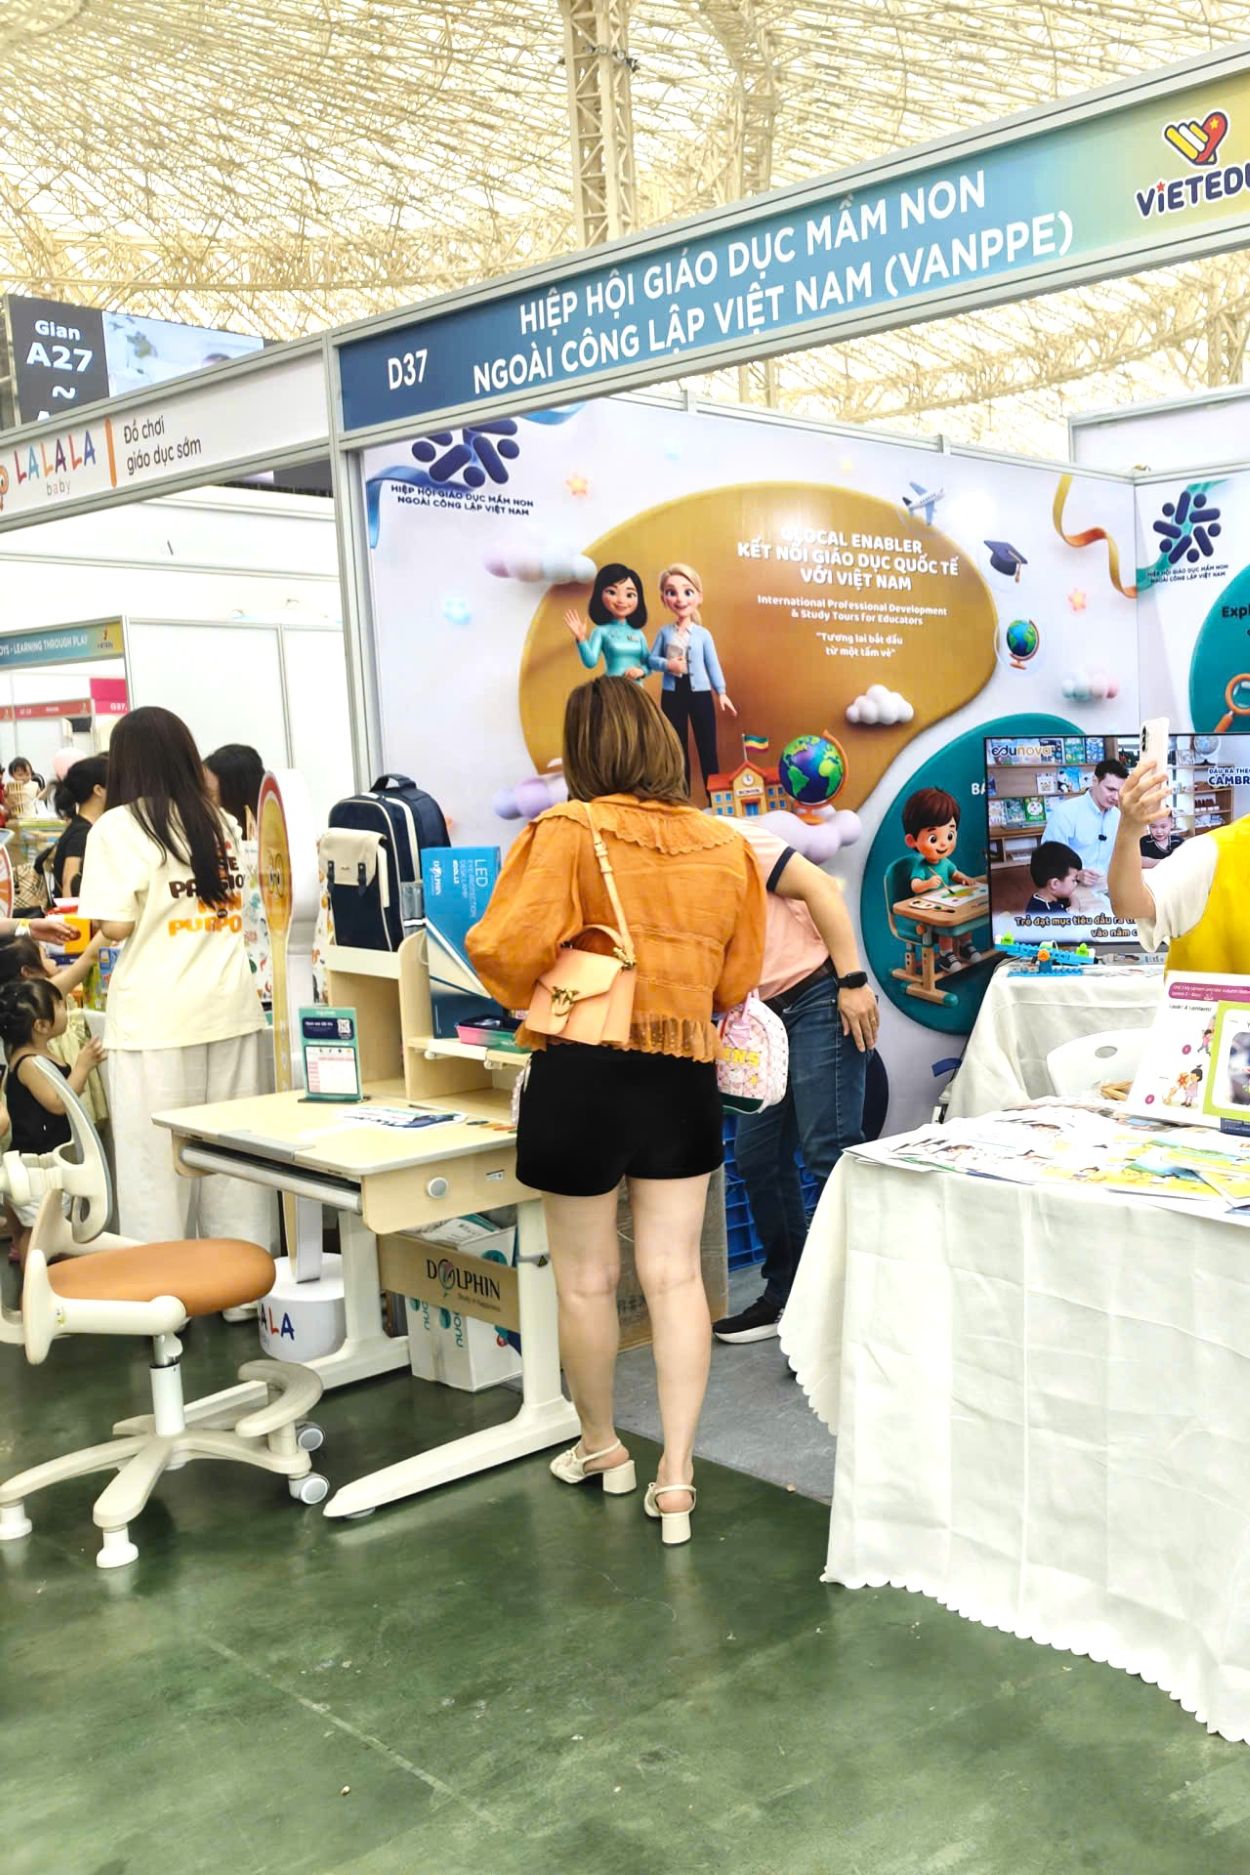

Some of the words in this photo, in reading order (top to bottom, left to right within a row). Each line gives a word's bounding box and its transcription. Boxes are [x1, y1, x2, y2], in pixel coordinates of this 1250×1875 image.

[520, 287, 577, 337] HIỆP
[586, 270, 634, 320] HỘI
[644, 248, 717, 299] GIÁO
[728, 227, 796, 280] DỤC
[901, 170, 985, 230] NON
[473, 341, 552, 394] NGOÀI
[561, 325, 639, 373] CÔNG
[649, 304, 705, 354] LẬP
[714, 283, 784, 334] VIỆT
[796, 262, 872, 315] NAM
[885, 210, 1073, 297] (VANPPE)
[35, 319, 81, 341] Gian
[26, 342, 93, 373] A27
[388, 349, 428, 391] D37
[142, 415, 165, 439] chơi
[127, 451, 150, 476] giáo
[153, 444, 174, 467] dục
[177, 437, 202, 459] sớm
[47, 480, 71, 496] baby
[508, 508, 529, 516] NAM
[738, 536, 771, 559] KẾT
[812, 548, 854, 567] GIÁO
[858, 554, 891, 572] DỤC
[894, 553, 938, 574] QUỐC
[941, 556, 959, 576] TẾ
[852, 534, 923, 554] ENABLER
[801, 565, 833, 585] VỚI
[837, 569, 872, 591] VIỆT
[876, 576, 912, 591] NAM
[757, 595, 826, 609] International
[828, 600, 887, 612] Professional
[889, 604, 948, 617] Development
[791, 609, 799, 618] &
[801, 609, 831, 621] Study
[832, 611, 860, 622] Tours
[861, 612, 876, 622] for
[878, 614, 923, 626] Educators
[14, 640, 43, 655] LEARNING
[43, 637, 72, 650] THROUGH
[72, 634, 88, 645] PLAY
[474, 859, 488, 888] LED
[1052, 917, 1071, 928] mục
[426, 1258, 501, 1301] DOLPHIN
